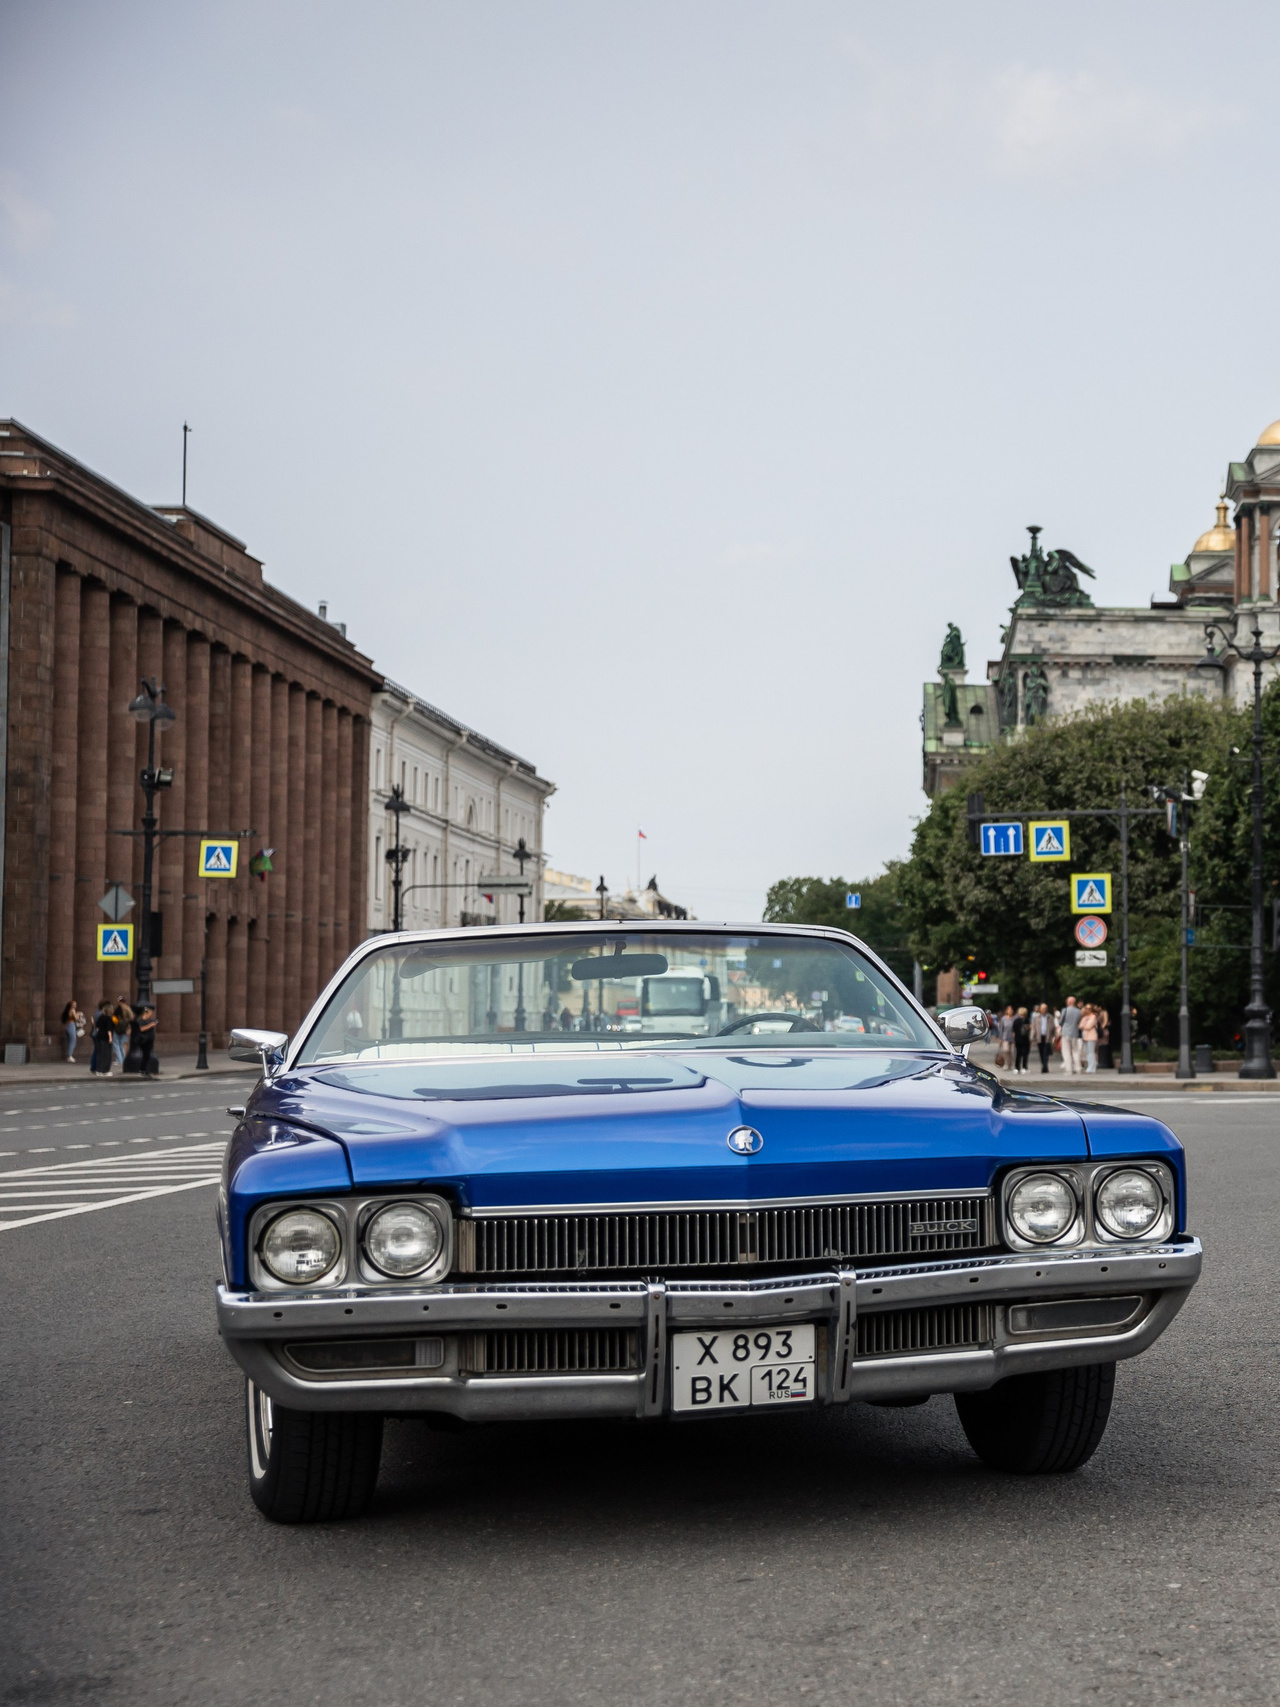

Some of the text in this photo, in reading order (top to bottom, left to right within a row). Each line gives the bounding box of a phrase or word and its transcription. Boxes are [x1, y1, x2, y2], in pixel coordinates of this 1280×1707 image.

[912, 1221, 973, 1233] BUICK
[732, 1330, 793, 1361] 893
[760, 1366, 808, 1391] 124
[769, 1389, 791, 1399] RUS
